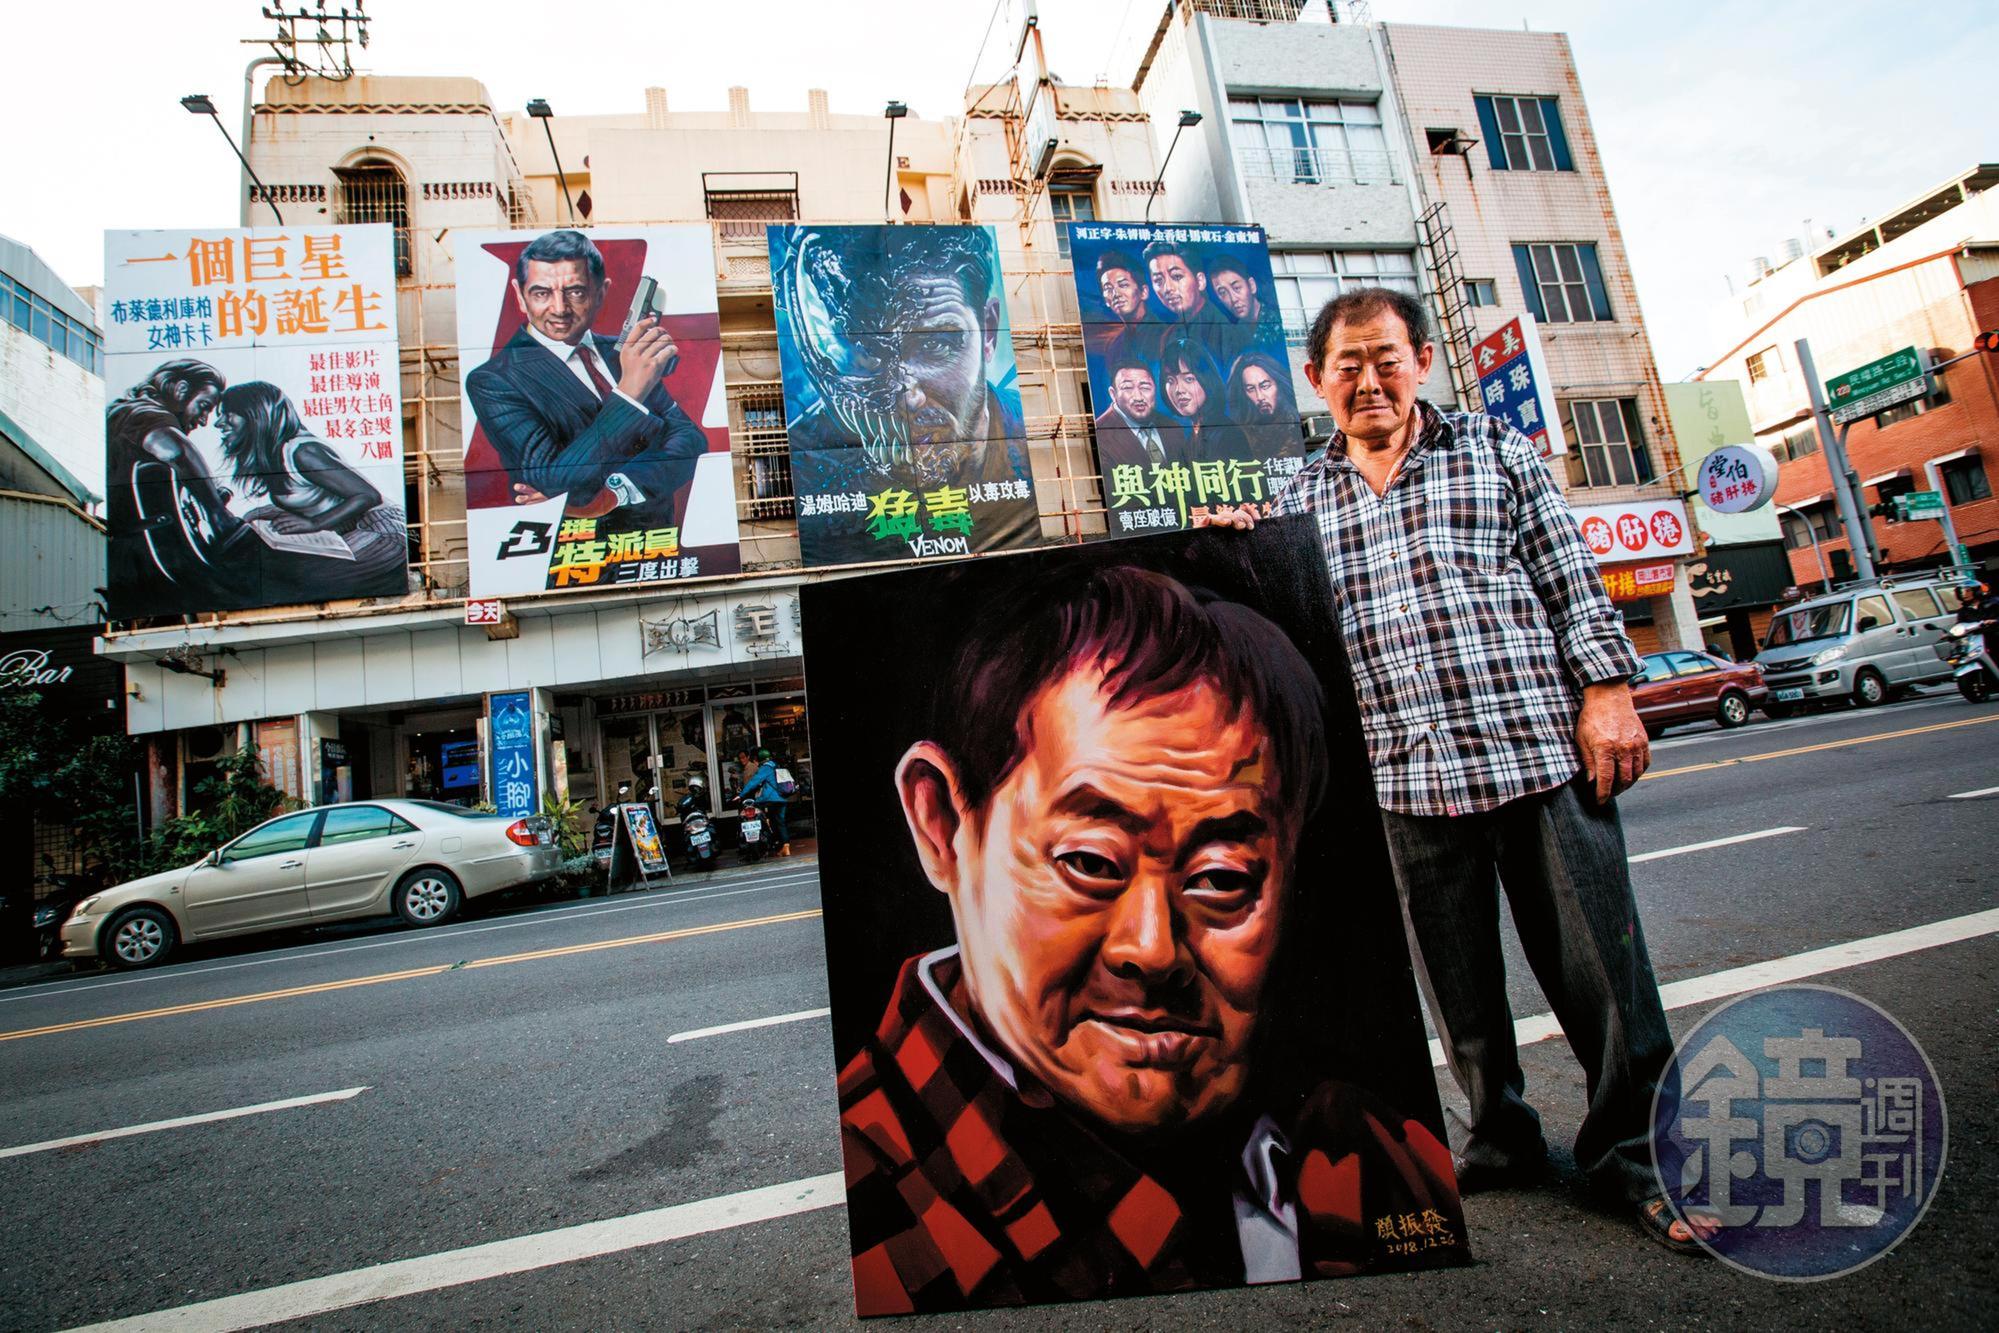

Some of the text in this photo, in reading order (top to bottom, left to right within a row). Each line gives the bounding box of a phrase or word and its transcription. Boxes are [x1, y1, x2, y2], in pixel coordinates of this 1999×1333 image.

[123, 233, 349, 287] 一個巨星
[111, 296, 212, 325] 布萊德利庫柏
[217, 284, 388, 338] 的誕生
[147, 322, 213, 350] 女神卡卡
[310, 350, 381, 372] 最佳影片
[311, 372, 380, 394] 最佳導演
[303, 393, 392, 418] 最佳男女主角
[326, 416, 392, 438] 最多金獎
[1709, 454, 1748, 482] 堂伯
[800, 491, 868, 517] 湯姆哈迪
[1111, 458, 1265, 530] 與神同行
[865, 485, 976, 543] 猛毒
[908, 533, 970, 557] VENOM
[1585, 515, 1680, 549] 豬肝捲
[616, 556, 700, 585] 三度出擊
[467, 602, 499, 623] 今天
[0, 649, 74, 688] Bar
[507, 751, 531, 817] 小腳
